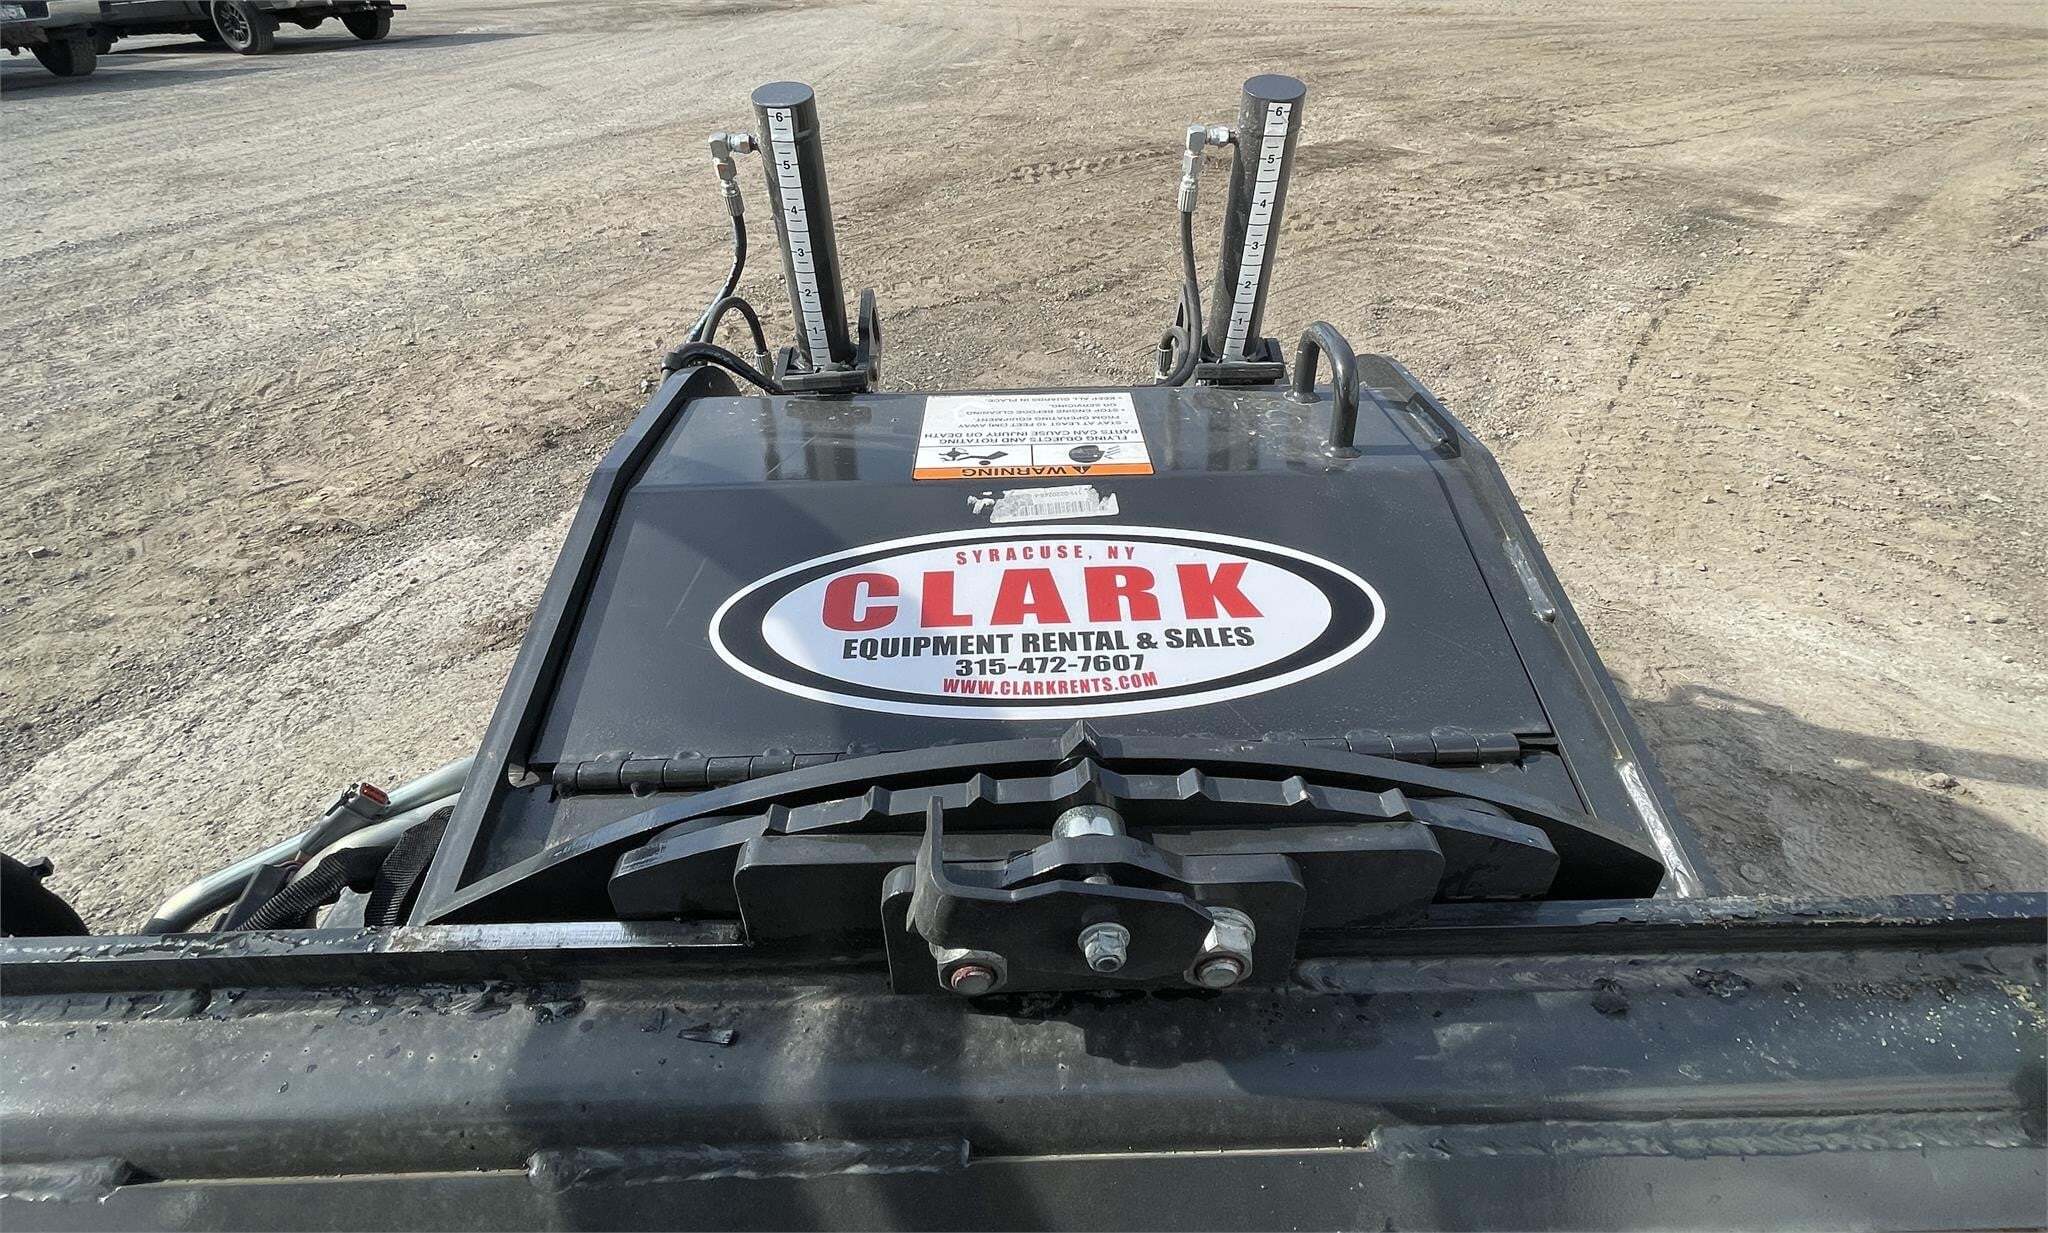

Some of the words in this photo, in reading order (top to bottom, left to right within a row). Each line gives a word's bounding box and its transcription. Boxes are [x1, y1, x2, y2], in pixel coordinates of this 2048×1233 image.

[1276, 107, 1284, 116] 6
[775, 112, 783, 122] 6
[1267, 155, 1275, 164] 5
[783, 161, 791, 170] 5
[1260, 199, 1267, 208] 4
[790, 206, 798, 214] 4
[1251, 241, 1259, 249] 3
[798, 248, 804, 256] 3
[805, 288, 812, 296] 2
[962, 466, 1067, 477] WARNING
[956, 545, 1095, 566] SYRACUSE,
[1108, 545, 1136, 561] NY
[821, 562, 1265, 632] CLARK
[842, 633, 1012, 661] EQUIPMENT
[1021, 631, 1131, 654] RENTAL
[1136, 630, 1158, 650] &
[1164, 625, 1256, 648] SALES
[955, 654, 1145, 676] 315-472-7607
[942, 671, 1158, 696] WWW.CLARKRENTS.COM
